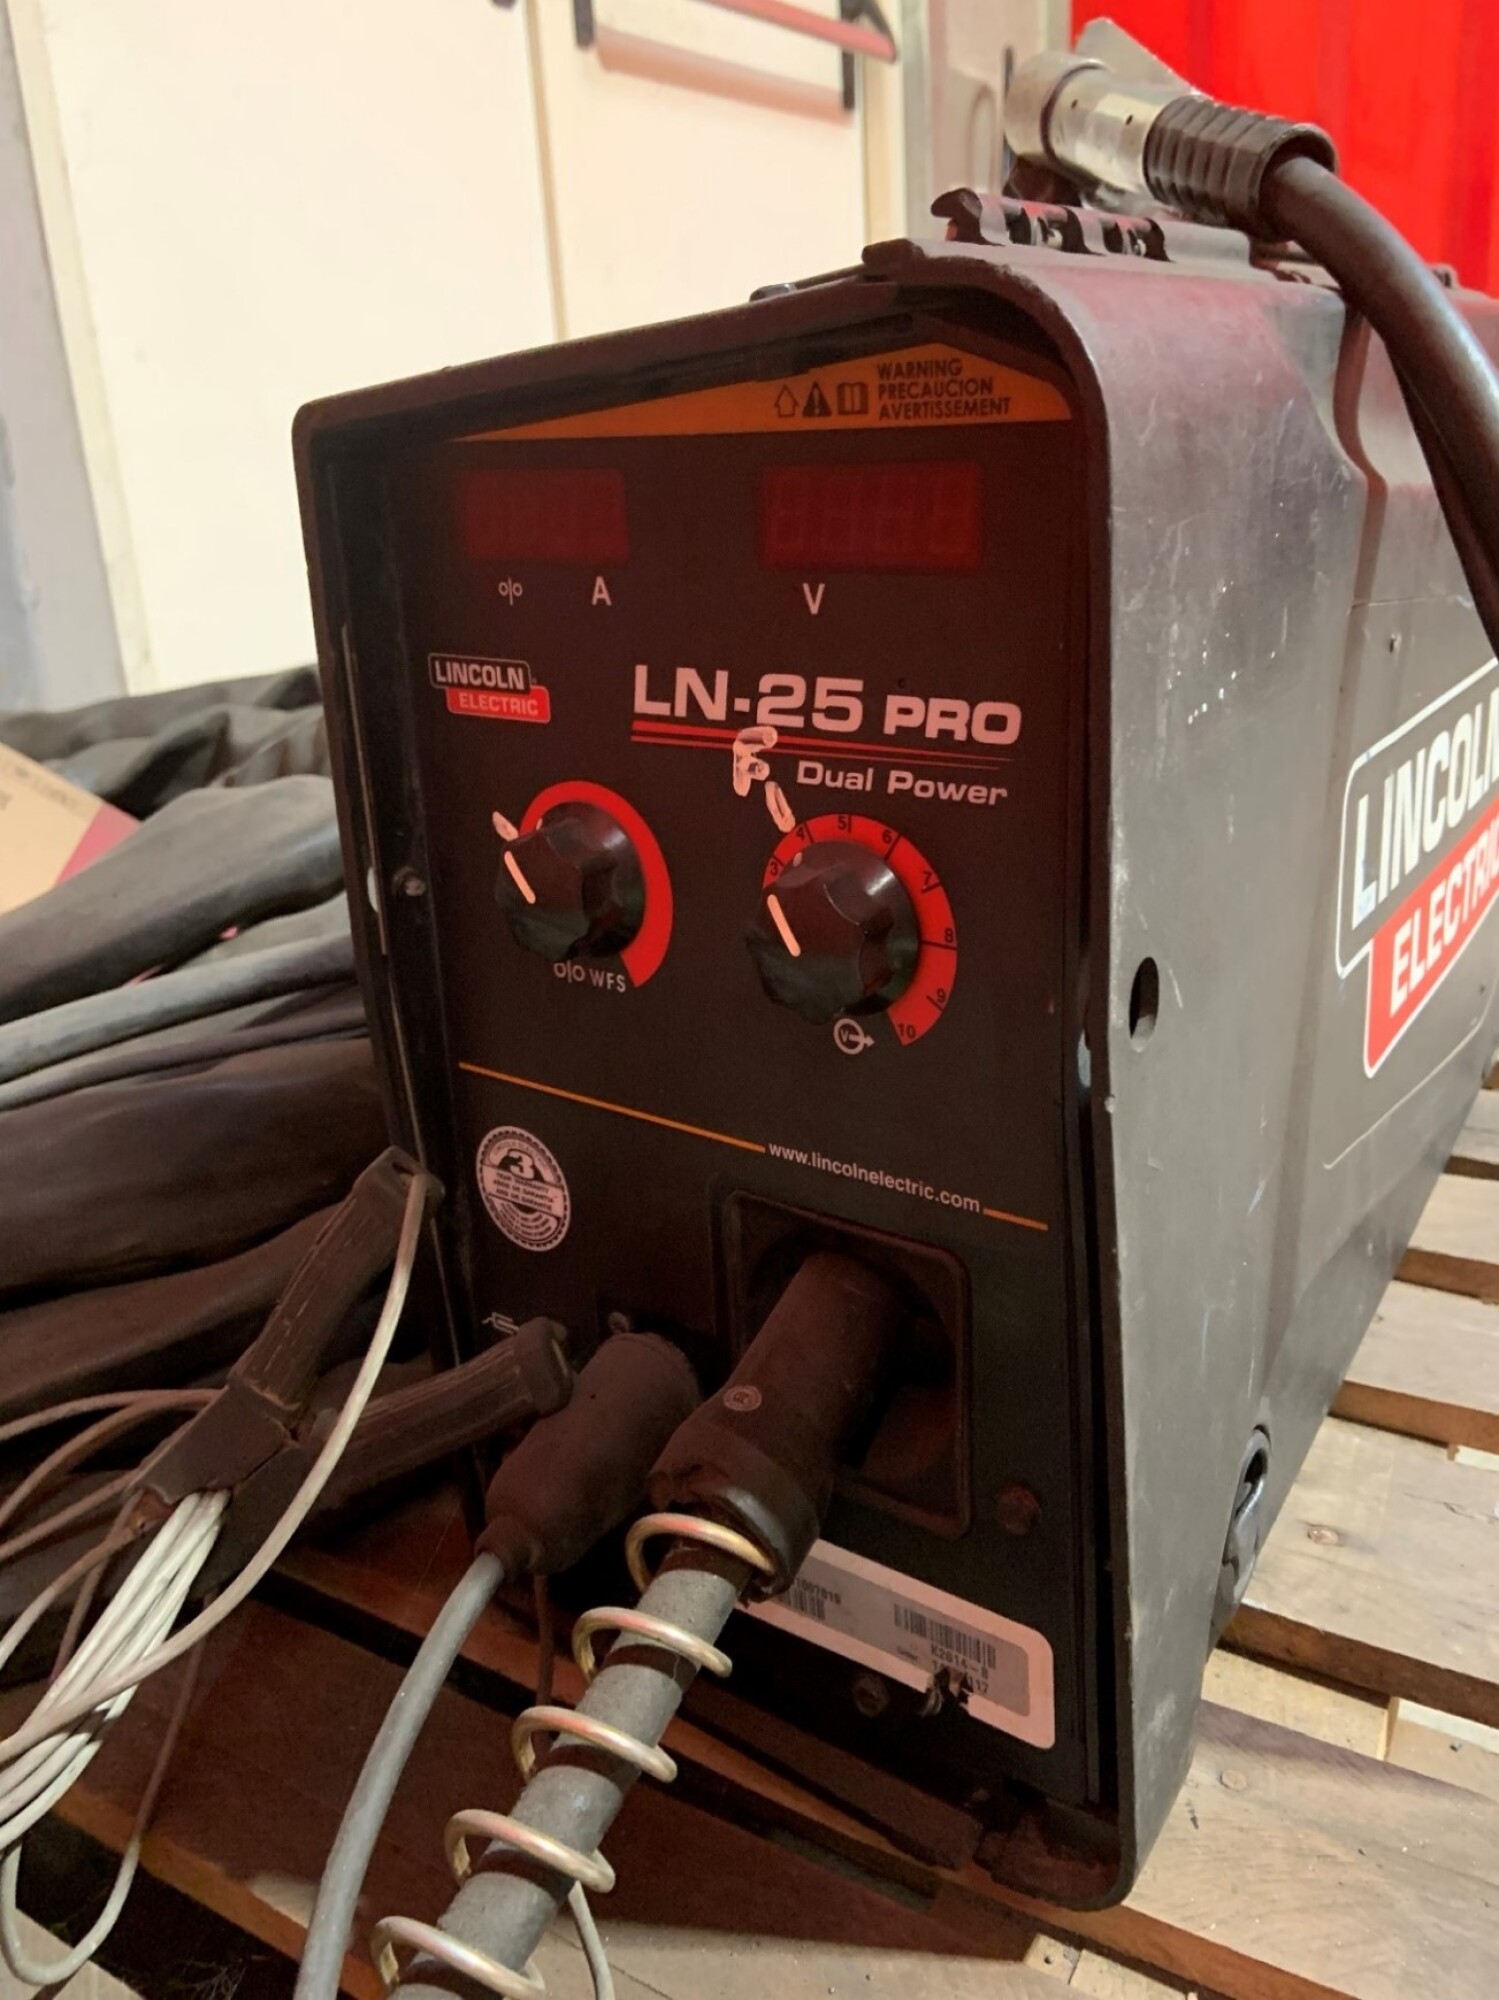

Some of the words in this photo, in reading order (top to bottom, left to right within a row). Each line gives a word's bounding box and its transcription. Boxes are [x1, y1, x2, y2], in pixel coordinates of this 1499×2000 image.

[877, 359, 962, 380] WARNING
[878, 376, 993, 400] PRECAUCION
[878, 396, 1012, 421] AVERTISSEMENT
[592, 576, 612, 606] A
[803, 583, 825, 614] V
[435, 660, 525, 691] LINCOLN
[458, 692, 539, 716] ELECTRIC
[633, 664, 864, 732] LN-25
[883, 694, 1022, 745] PRO
[796, 760, 873, 792] Dual
[887, 769, 1008, 806] Power
[1353, 687, 1499, 930] LINCOLN
[796, 827, 807, 841] 4
[837, 816, 847, 831] 5
[881, 829, 892, 845] 6
[769, 859, 779, 876] 3
[922, 870, 932, 884] 7
[944, 927, 954, 943] 8
[589, 967, 627, 994] WFS
[937, 988, 946, 1004] 9
[898, 1022, 916, 1039] 10
[507, 1148, 535, 1181] 3
[768, 1142, 981, 1215] www.lincolnelectric.com
